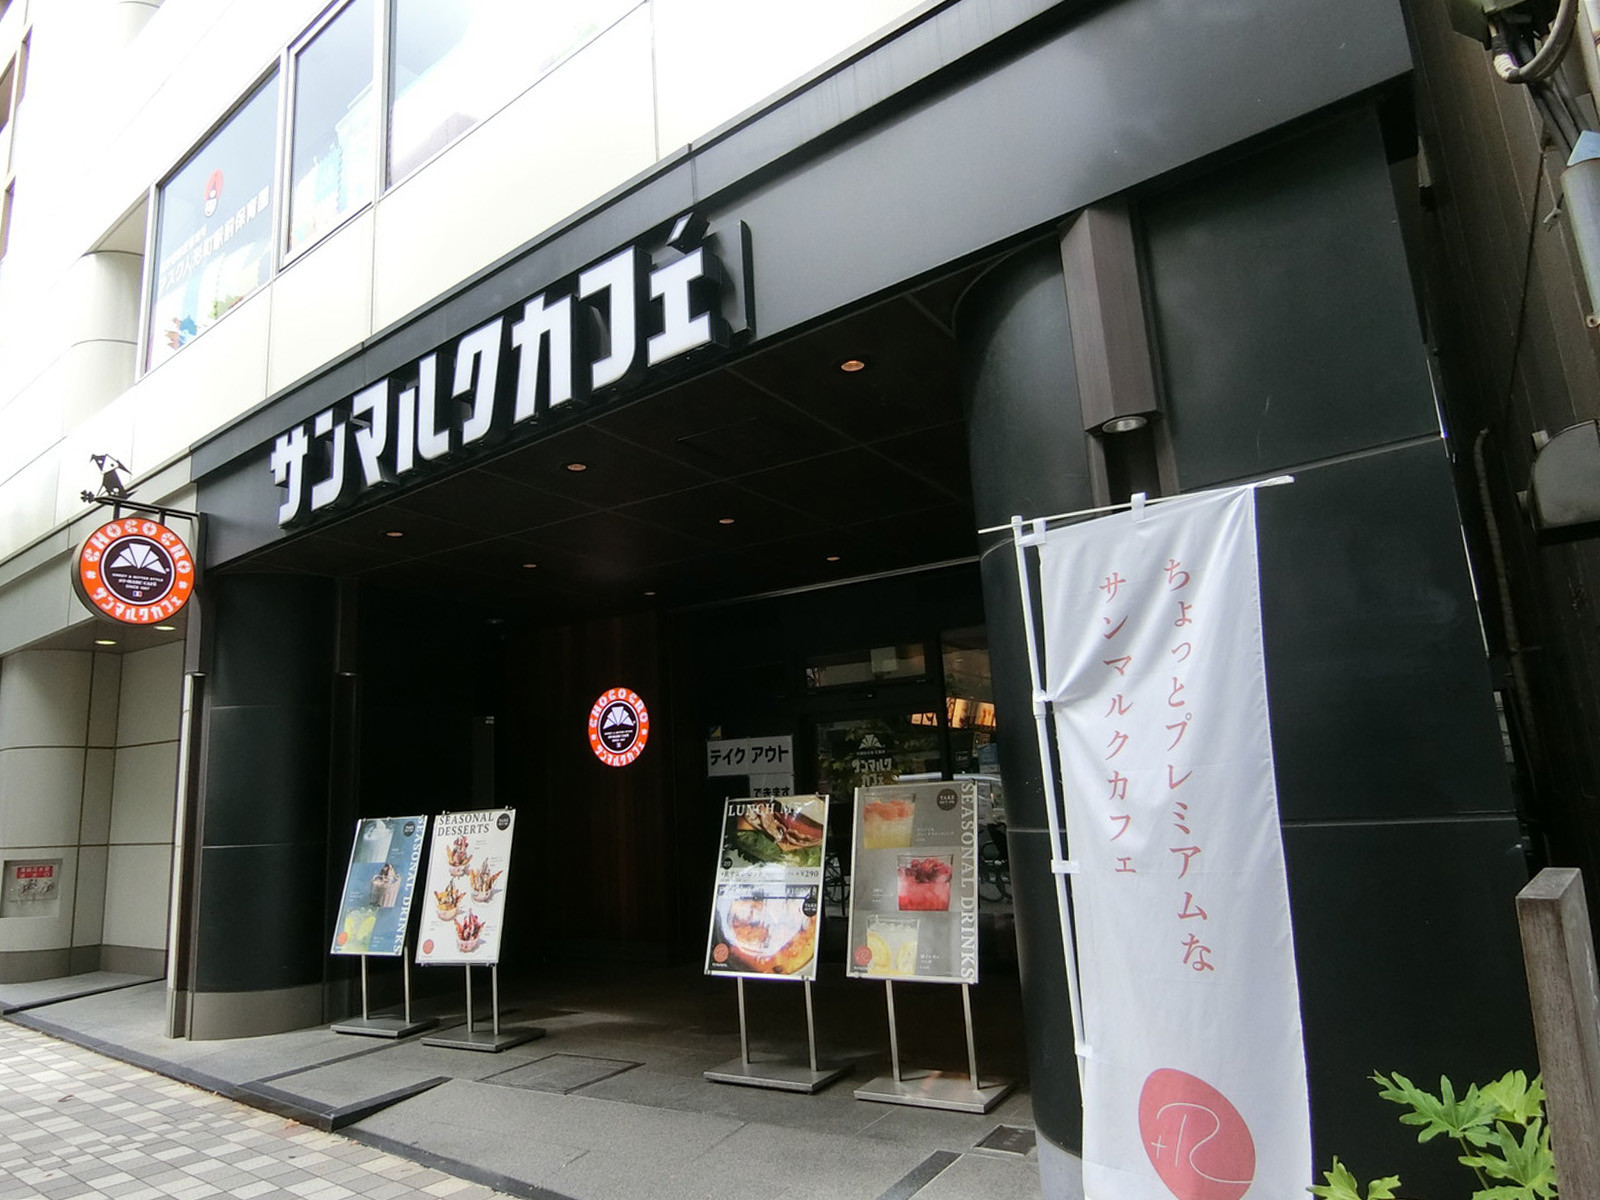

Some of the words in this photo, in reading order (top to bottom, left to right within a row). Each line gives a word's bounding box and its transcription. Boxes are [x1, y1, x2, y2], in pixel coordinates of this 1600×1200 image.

[271, 213, 712, 528] サンマルクカフェ
[84, 519, 157, 562] CHOCO
[161, 532, 191, 574] CRO
[93, 587, 183, 621] サンマルクカフェ
[589, 688, 627, 728] CHOCO
[1099, 571, 1137, 875] サンマルクカフェ
[710, 746, 746, 766] テイク
[751, 744, 790, 764] アウト
[851, 756, 892, 774] サンマルク
[1163, 558, 1215, 972] ちょっとプレミアムな
[437, 823, 490, 837] DESSERTS
[439, 812, 495, 825] SEASONAL
[728, 803, 775, 817] LUNCH
[961, 782, 975, 888] SEASONAL
[405, 815, 426, 890] SEASONAL
[393, 896, 412, 953] DRINKS
[960, 897, 976, 979] DRINKS
